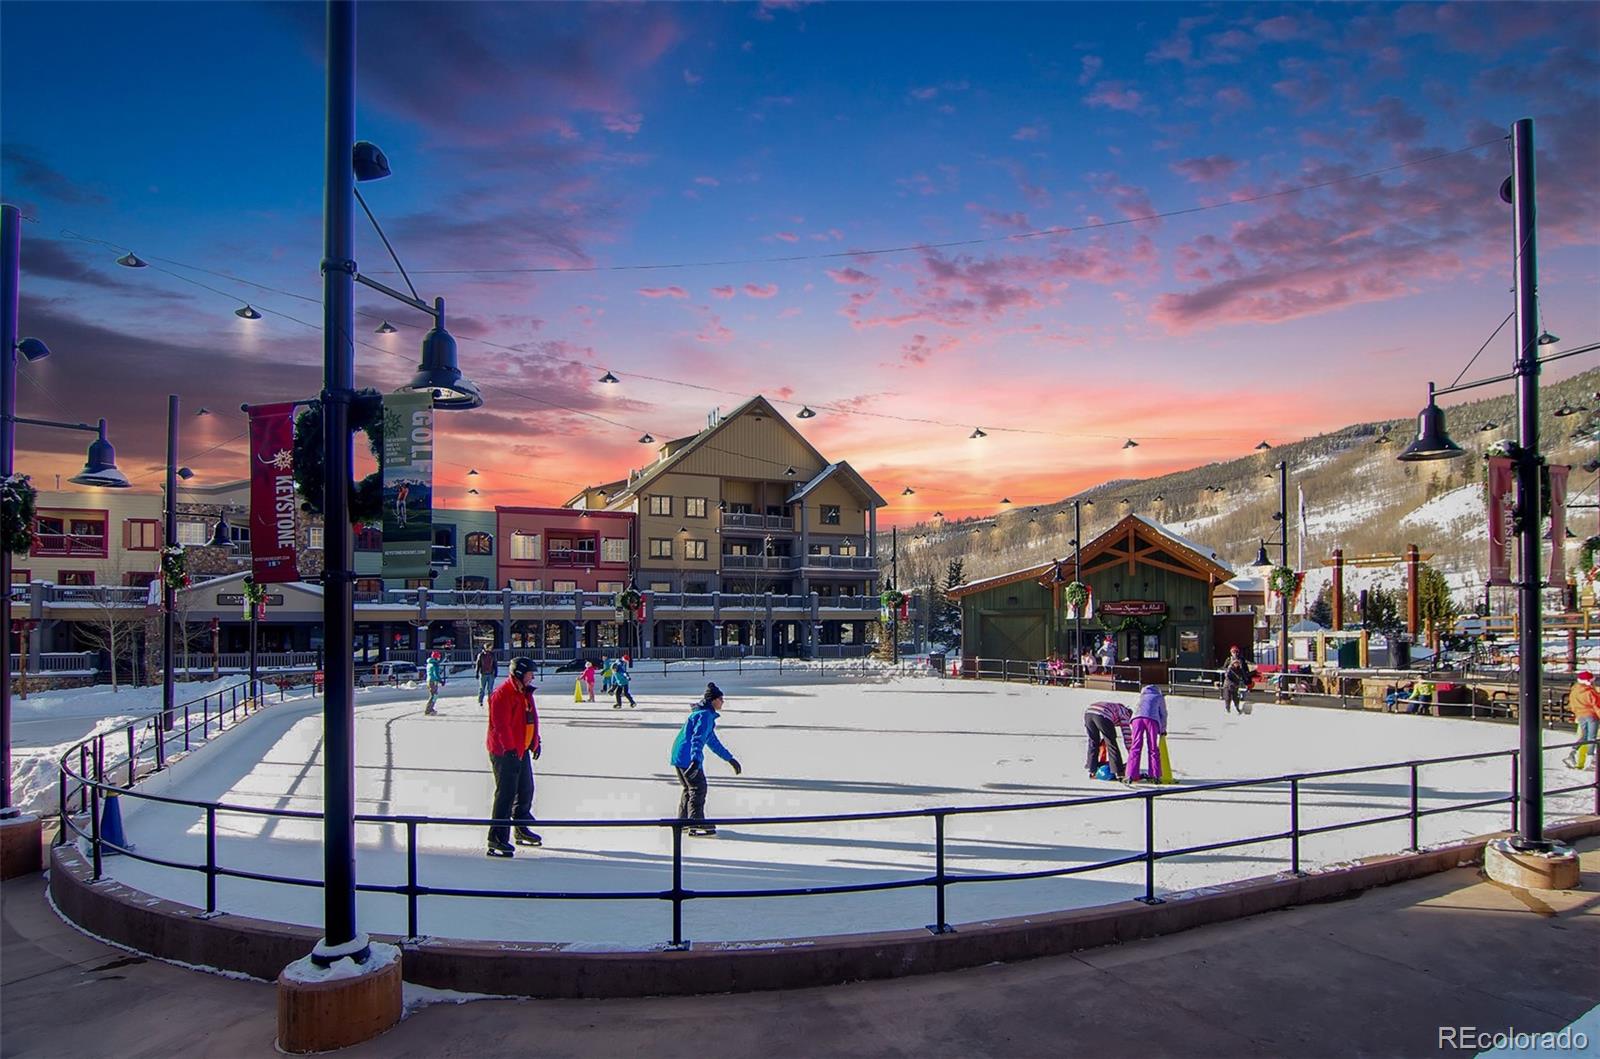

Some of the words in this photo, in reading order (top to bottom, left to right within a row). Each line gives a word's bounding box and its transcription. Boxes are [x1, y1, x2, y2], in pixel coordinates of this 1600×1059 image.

[411, 410, 433, 472] GOLF
[275, 475, 296, 549] KEYSTONE
[1503, 509, 1515, 562] KEYSTONE
